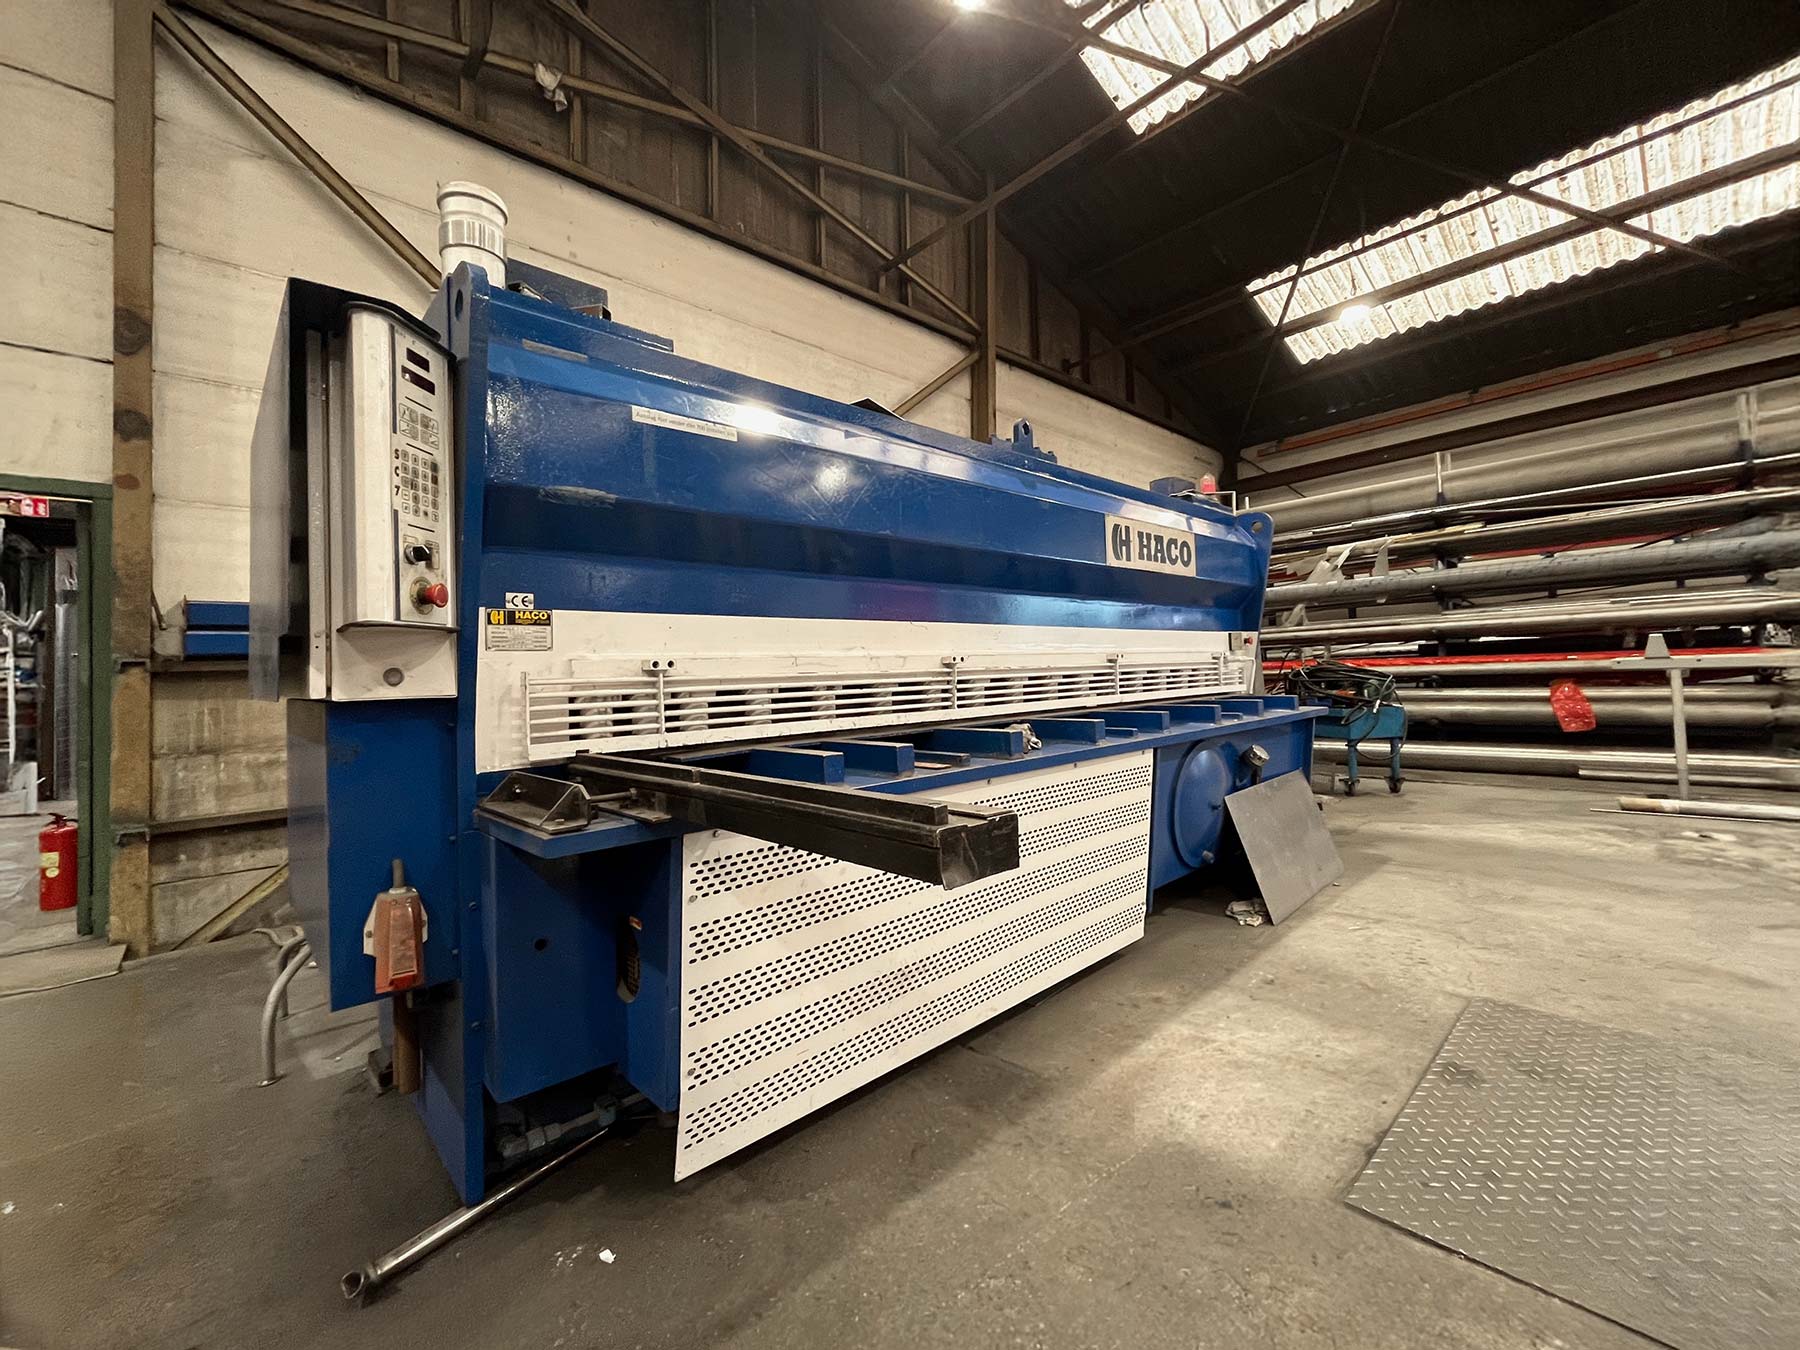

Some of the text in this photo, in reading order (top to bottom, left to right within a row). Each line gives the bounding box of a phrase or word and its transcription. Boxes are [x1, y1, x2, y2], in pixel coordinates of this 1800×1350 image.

[1137, 530, 1192, 568] HACO
[511, 595, 529, 608] CE
[515, 610, 548, 620] HACO
